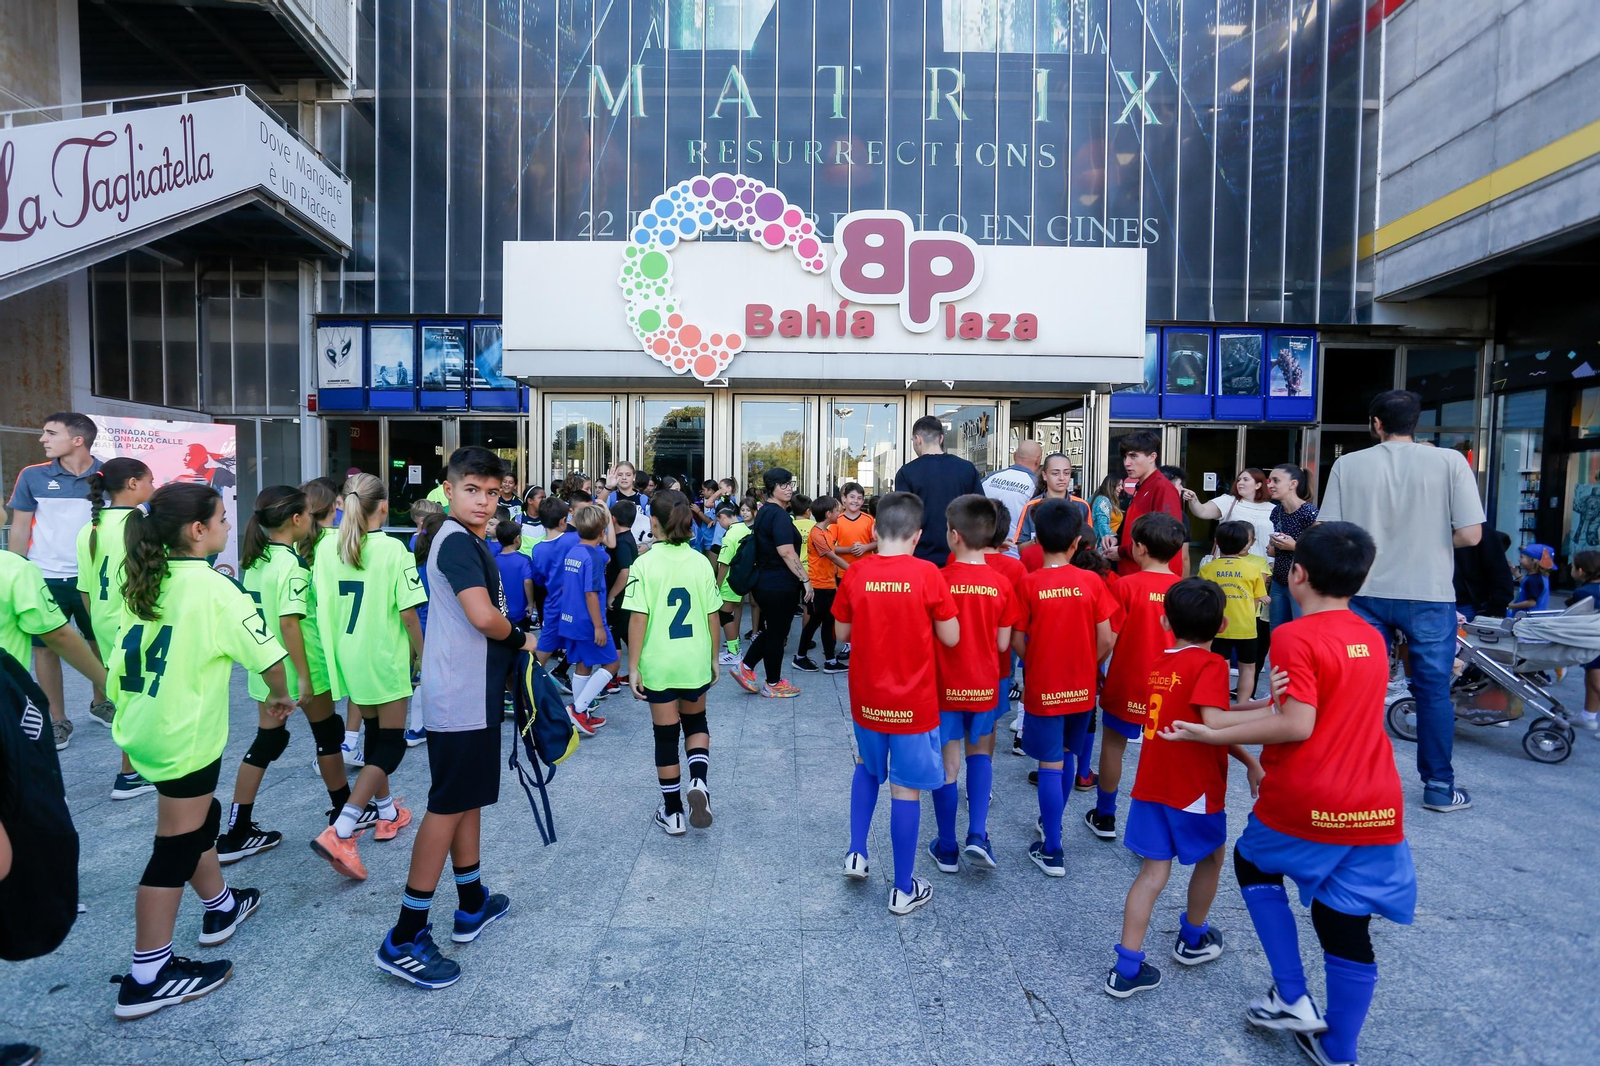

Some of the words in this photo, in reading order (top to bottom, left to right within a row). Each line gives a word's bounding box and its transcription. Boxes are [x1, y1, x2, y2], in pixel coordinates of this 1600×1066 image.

[582, 64, 1162, 126] MATRIX
[687, 139, 1057, 169] RESURRECTIONS
[260, 121, 291, 164] Dove
[296, 151, 342, 205] Mangiare
[0, 140, 47, 242] La
[51, 113, 214, 228] Tagliatella
[269, 161, 277, 186] è
[282, 176, 296, 200] un
[300, 186, 337, 229] Piacere
[577, 210, 615, 237] 22
[980, 213, 1035, 241] EN
[1046, 215, 1160, 244] CINES
[745, 299, 876, 338] Bahía
[125, 443, 155, 451] PLAZA
[155, 438, 184, 446] CALLE
[990, 477, 1031, 491] BALONMANO
[99, 555, 110, 600] 4
[1216, 570, 1234, 578] RAFA
[865, 581, 902, 593] MARTIN
[903, 582, 912, 593] P.
[950, 584, 999, 597] ALEJANDRO
[1038, 586, 1072, 600] MARTÍN
[1072, 587, 1083, 597] G.
[338, 580, 365, 635] 7
[667, 586, 694, 640] 2
[1346, 643, 1370, 659] IKER
[119, 624, 173, 698] 14
[946, 688, 994, 697] BALONMANO
[1041, 688, 1089, 701] BALONMANO
[861, 705, 914, 718] BALONMANO
[862, 713, 880, 722] CIUDAD
[1311, 807, 1396, 822] BALONMANO
[1311, 820, 1346, 829] CIUDAD
[1352, 818, 1396, 829] ALGECIRAS
